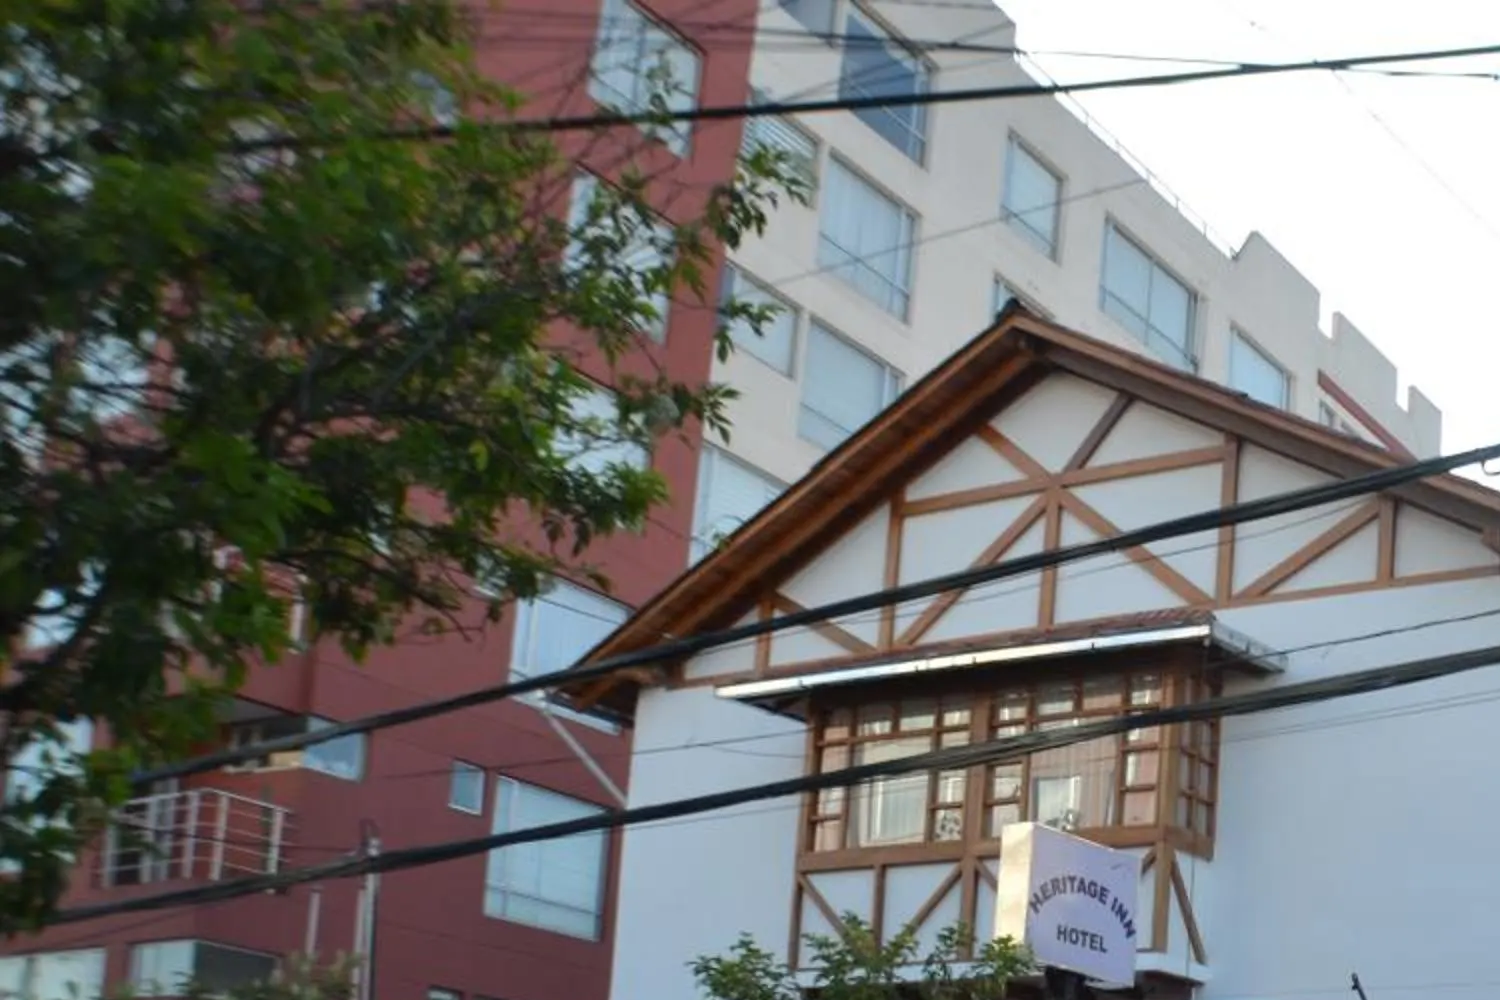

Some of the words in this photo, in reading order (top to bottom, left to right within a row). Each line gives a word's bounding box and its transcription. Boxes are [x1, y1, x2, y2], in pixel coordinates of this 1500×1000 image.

[1029, 874, 1111, 914] HERITAGE
[1111, 896, 1136, 939] INN
[1056, 924, 1108, 954] HOTEL
